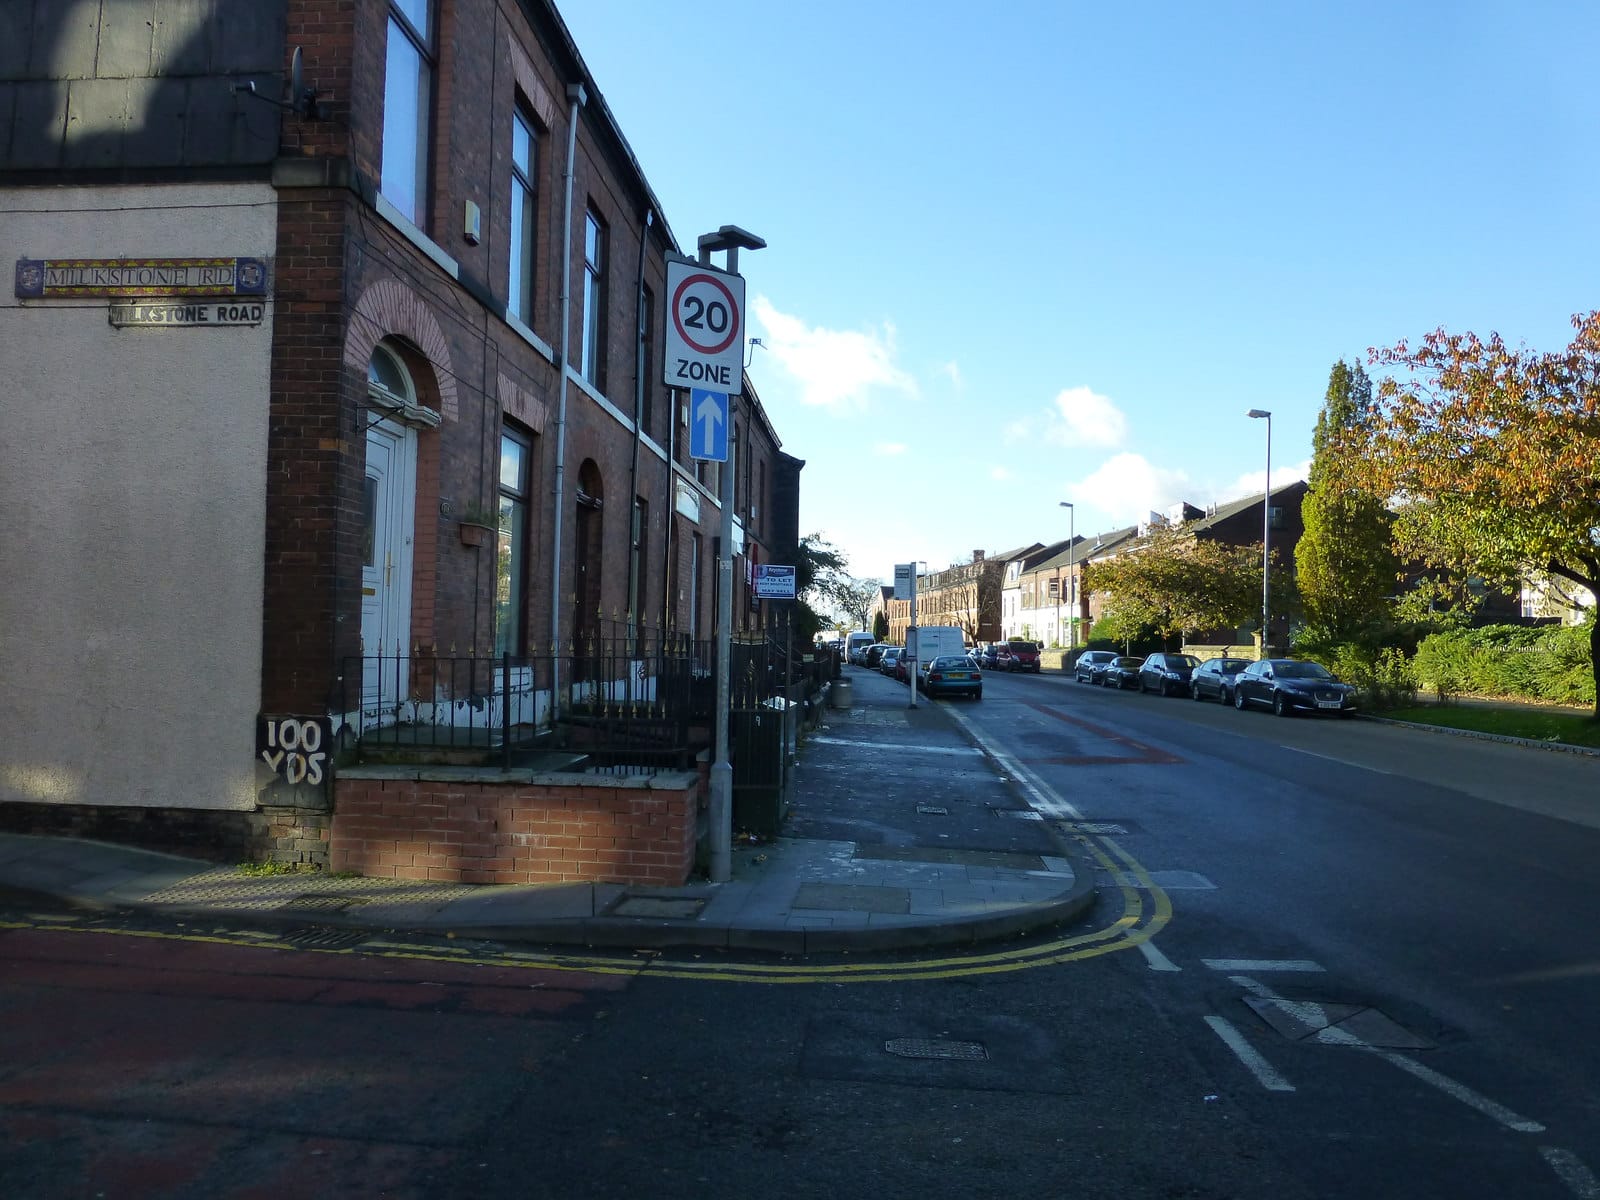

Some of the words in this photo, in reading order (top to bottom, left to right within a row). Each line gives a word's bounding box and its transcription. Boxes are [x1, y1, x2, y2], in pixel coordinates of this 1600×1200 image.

[50, 267, 186, 286] MILKSTONE
[202, 267, 233, 284] RD
[217, 306, 262, 322] ROAD
[684, 296, 728, 333] 20
[677, 359, 731, 385] ZONE
[268, 719, 321, 752] 100
[262, 750, 325, 785] YDS
